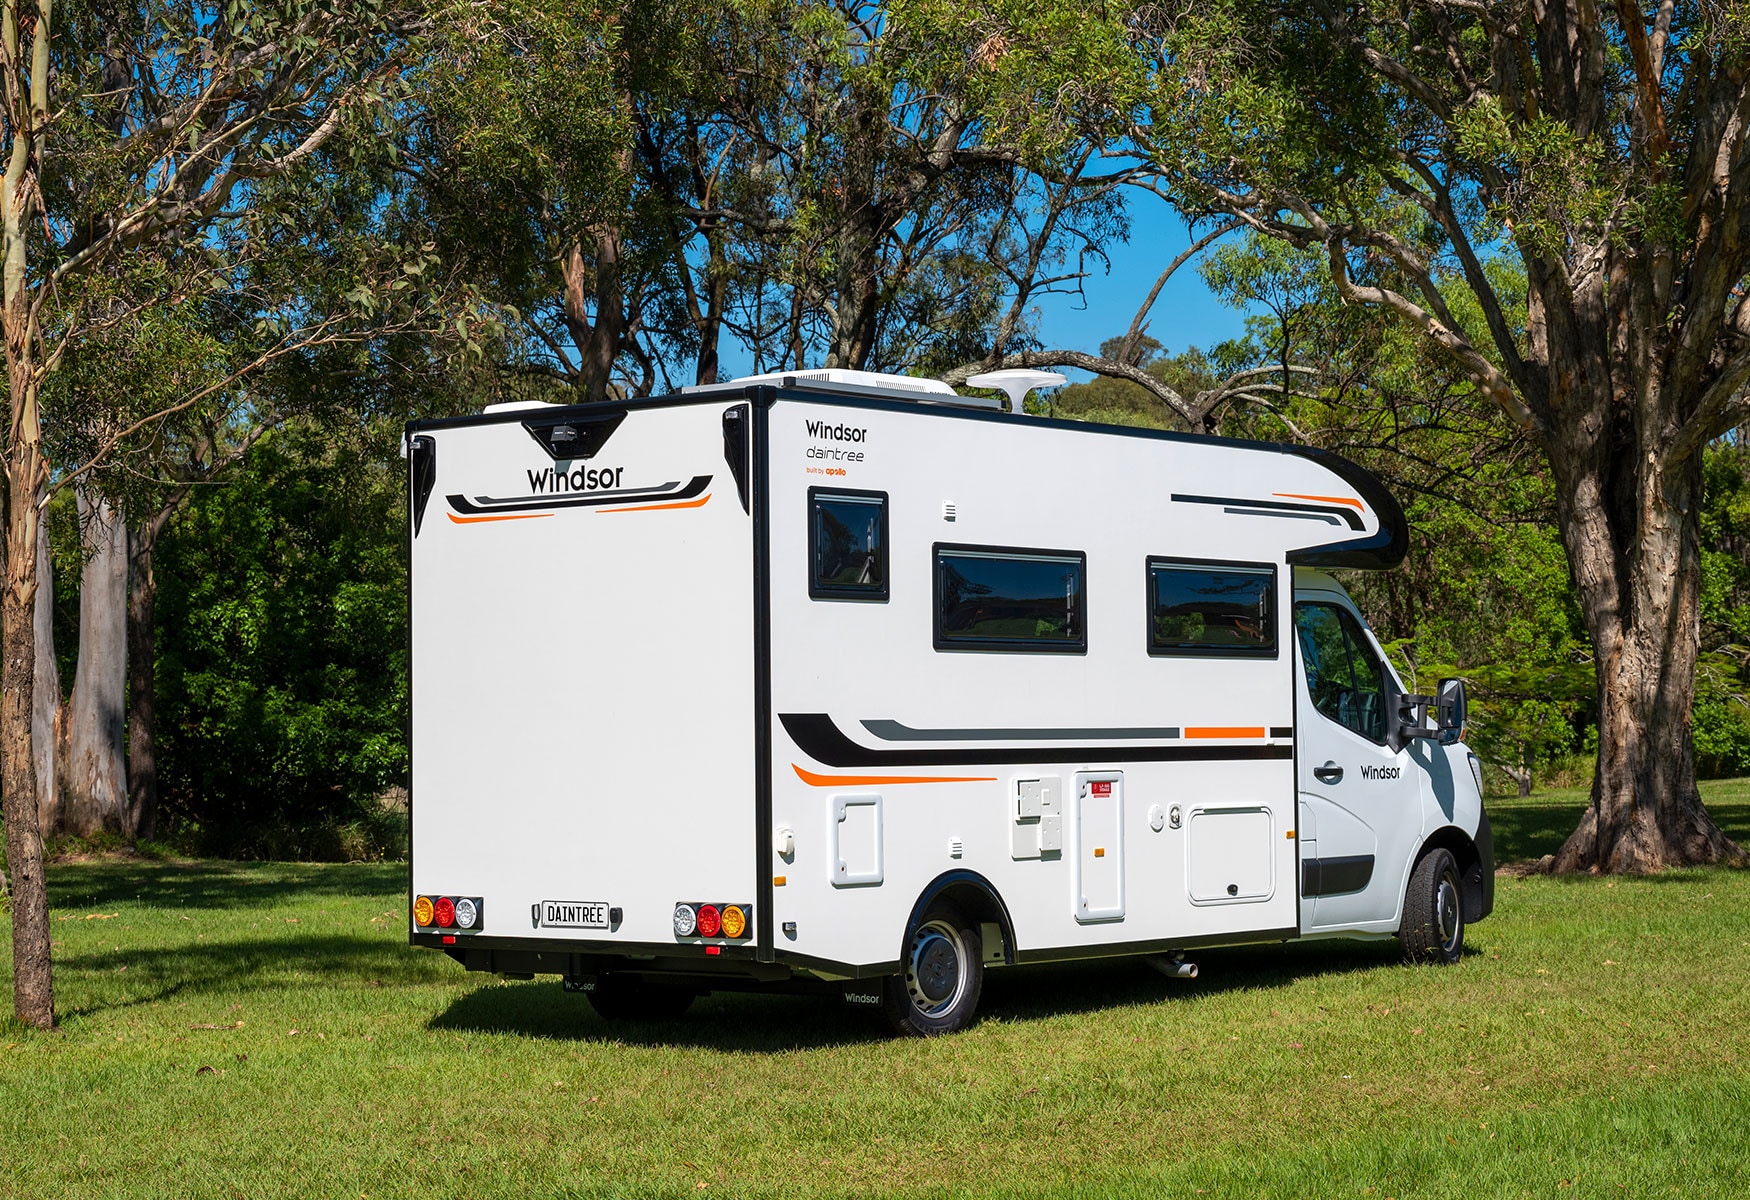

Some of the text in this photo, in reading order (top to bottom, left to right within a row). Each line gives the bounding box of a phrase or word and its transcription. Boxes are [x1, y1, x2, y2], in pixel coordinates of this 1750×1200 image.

[805, 419, 867, 443] Windsor
[806, 445, 864, 462] daintree
[527, 465, 624, 494] Windsor
[825, 467, 846, 476] apollo
[1360, 765, 1400, 780] Windsor
[548, 905, 604, 923] DAINTREE
[844, 992, 879, 1004] Windsor
